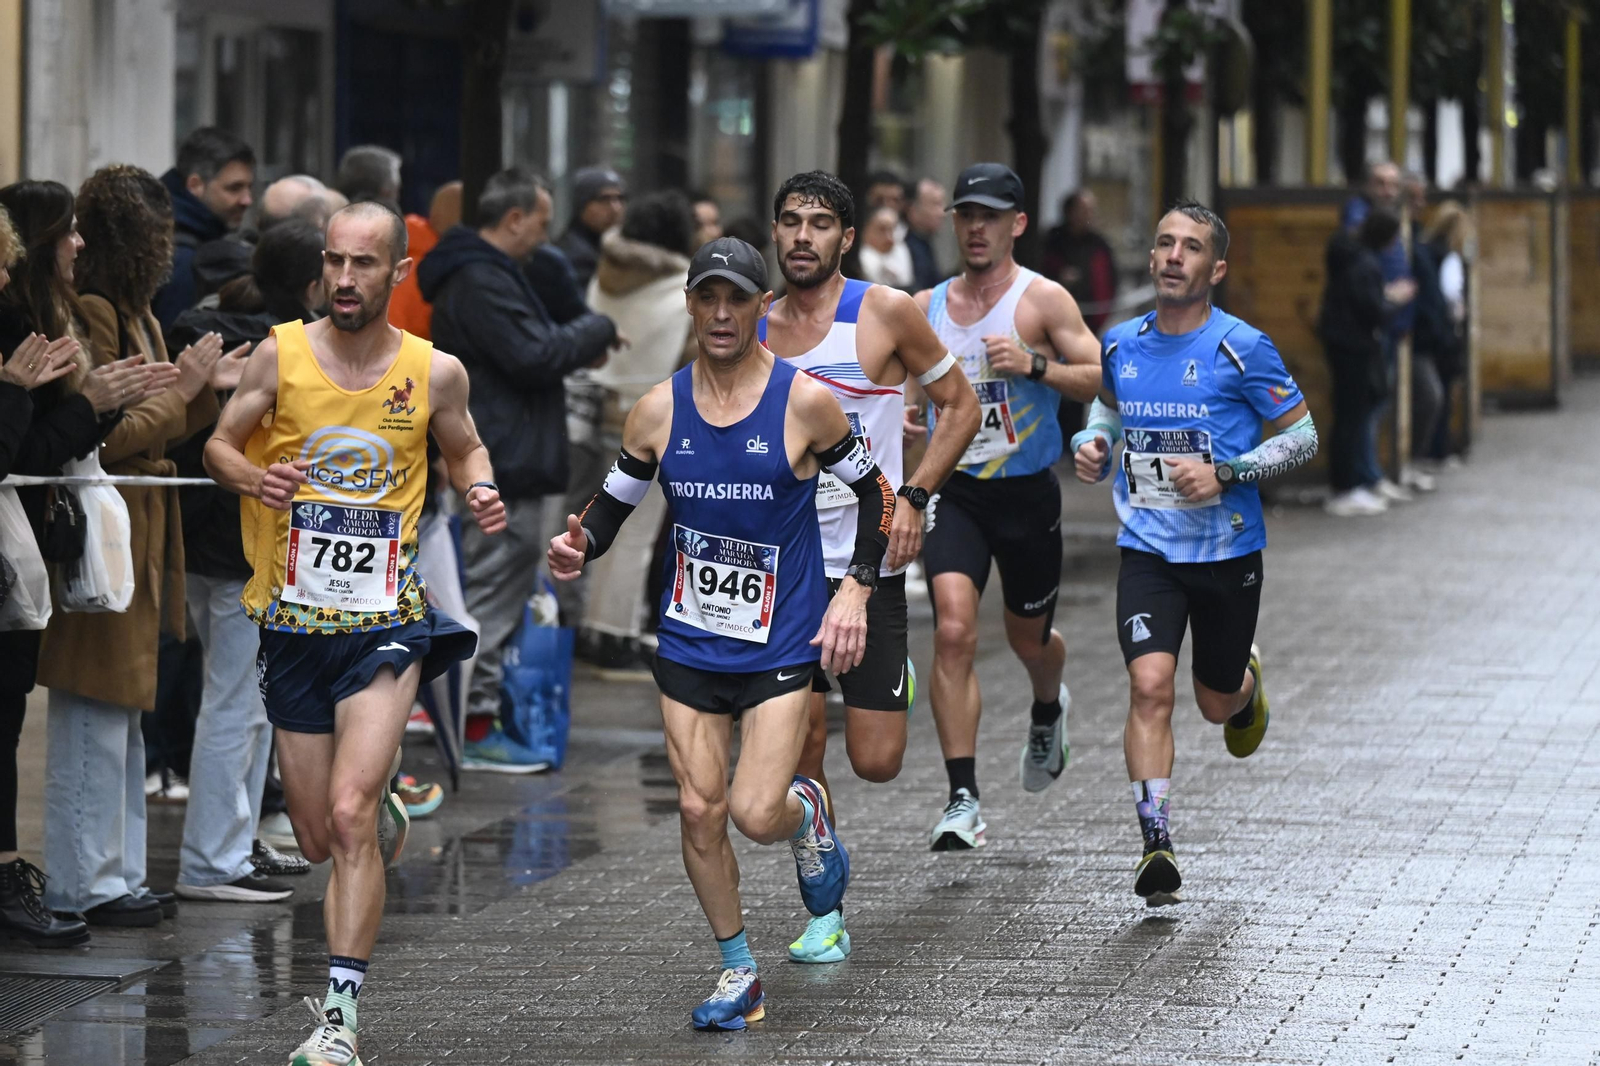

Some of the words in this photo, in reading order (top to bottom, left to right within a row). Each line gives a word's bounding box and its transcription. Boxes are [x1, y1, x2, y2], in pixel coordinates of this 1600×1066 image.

[984, 407, 1002, 430] 4
[1160, 432, 1189, 440] MEDIA
[669, 482, 774, 500] TROTASIERRA
[816, 481, 836, 490] ANUEL
[343, 508, 380, 520] MEDIA
[303, 512, 324, 530] 39
[720, 540, 754, 555] MEDIA
[312, 536, 376, 574] 782
[328, 578, 350, 588] JESÚS
[686, 562, 762, 604] 1946
[350, 598, 382, 606] IMDECO
[701, 602, 732, 614] ANTONIO
[724, 622, 754, 634] IMDECO
